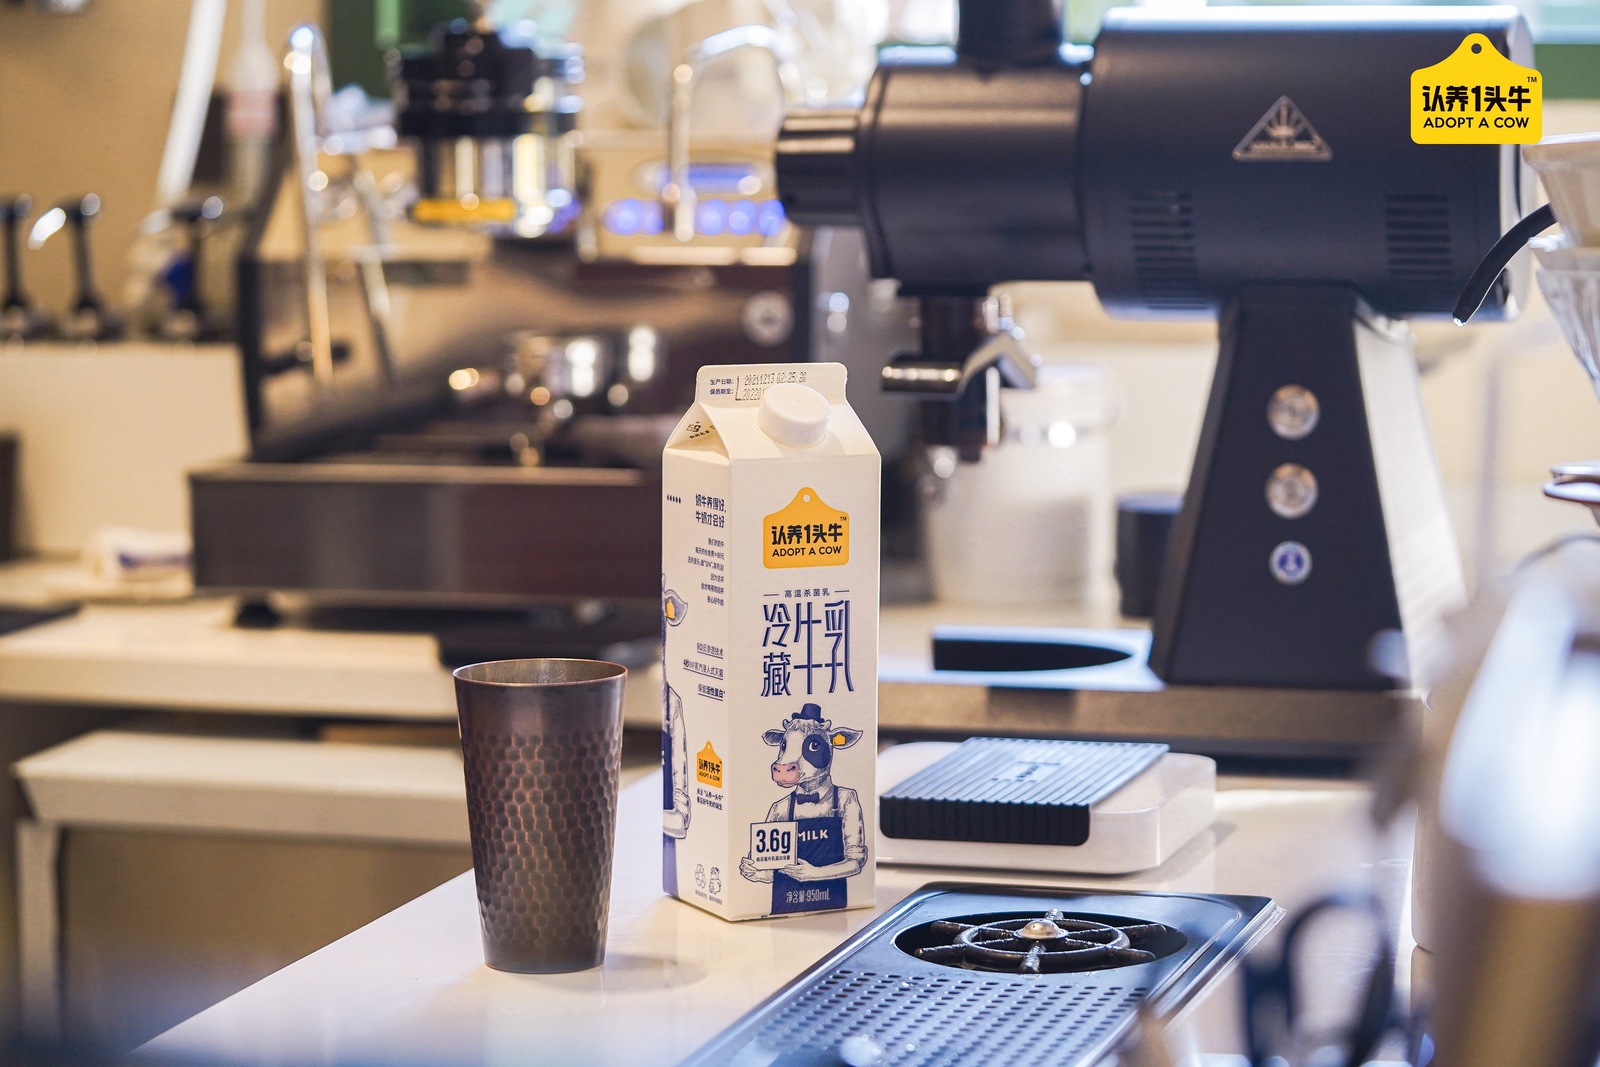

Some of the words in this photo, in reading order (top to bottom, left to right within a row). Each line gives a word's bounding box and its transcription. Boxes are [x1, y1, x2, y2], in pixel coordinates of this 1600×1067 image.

[695, 510, 725, 528] 牛奶才会好
[771, 523, 843, 545] 认养1头牛
[772, 547, 806, 557] ADOPT
[809, 547, 816, 555] A
[819, 546, 842, 555] COW
[784, 588, 830, 598] 高温杀菌乳
[756, 828, 791, 854] 3.6g
